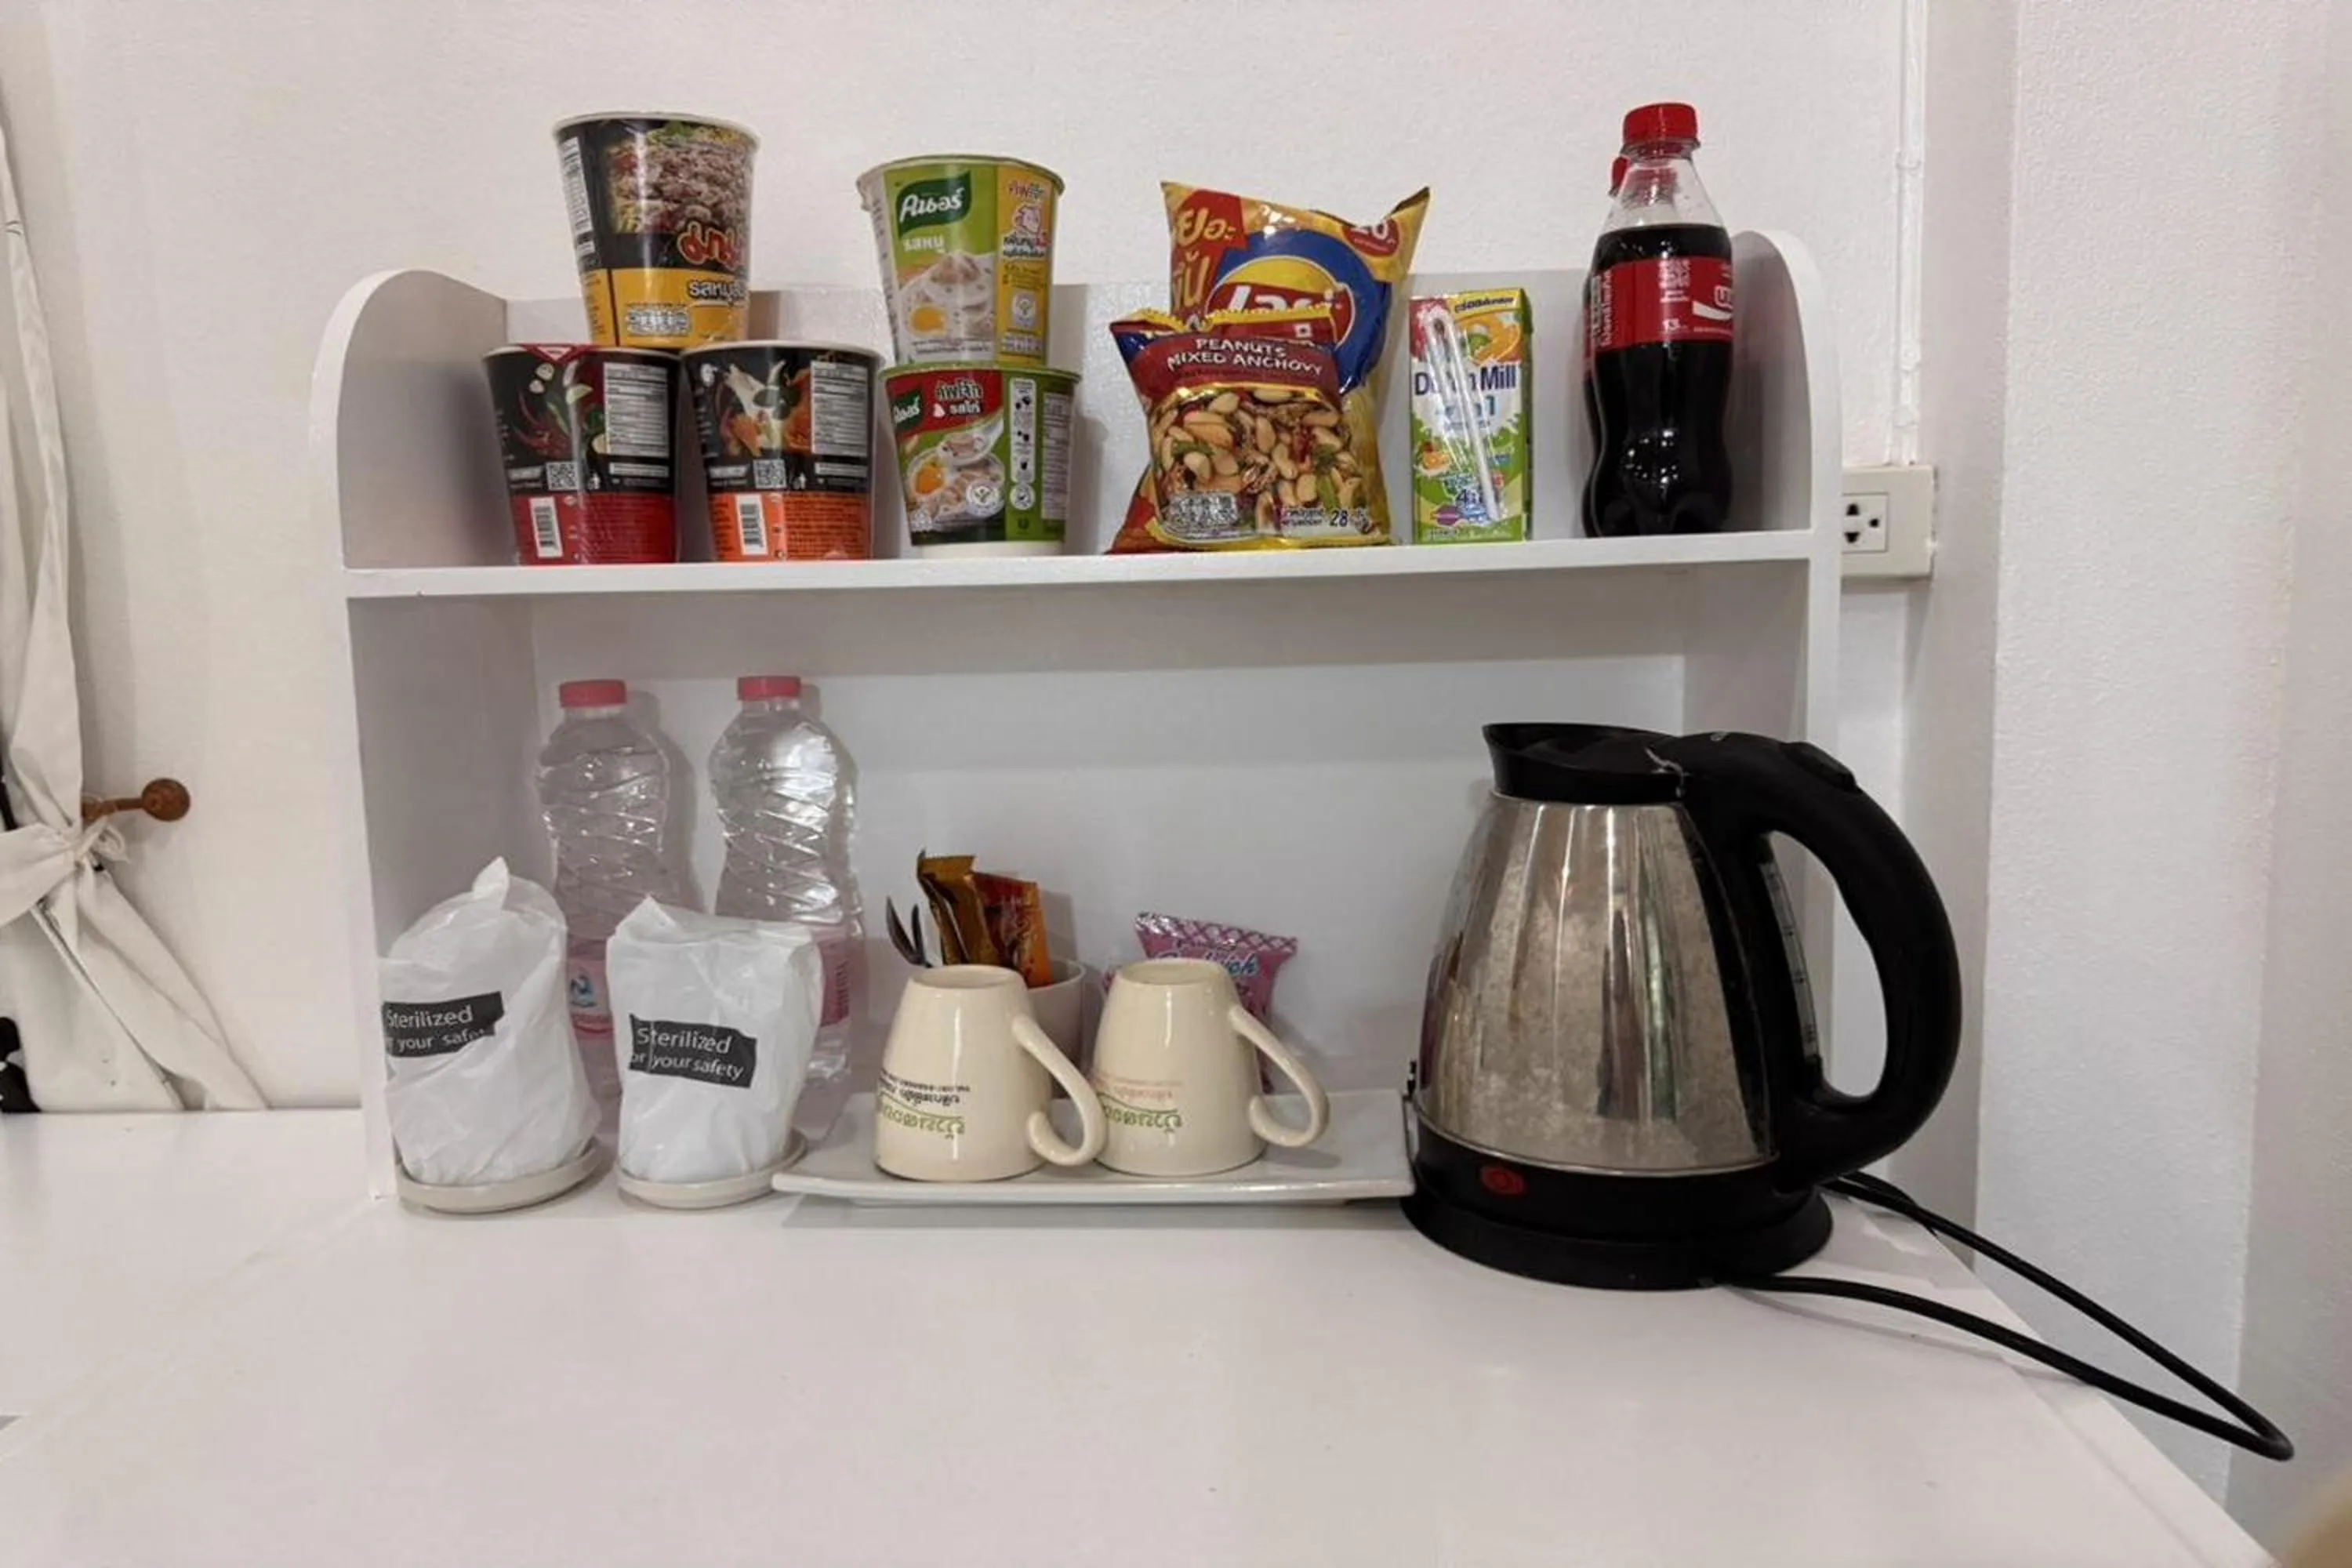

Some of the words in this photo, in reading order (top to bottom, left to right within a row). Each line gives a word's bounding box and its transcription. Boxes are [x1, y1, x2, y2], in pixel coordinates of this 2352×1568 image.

[1196, 338, 1287, 358] PEANUTS
[1167, 351, 1227, 371] MIXED
[1232, 354, 1323, 376] ANCHOVY
[1480, 365, 1516, 390] Mill
[1330, 509, 1348, 527] 28
[397, 1036, 434, 1053] your
[637, 1027, 733, 1054] Sterilized
[652, 1054, 691, 1070] your
[691, 1058, 744, 1082] safety
